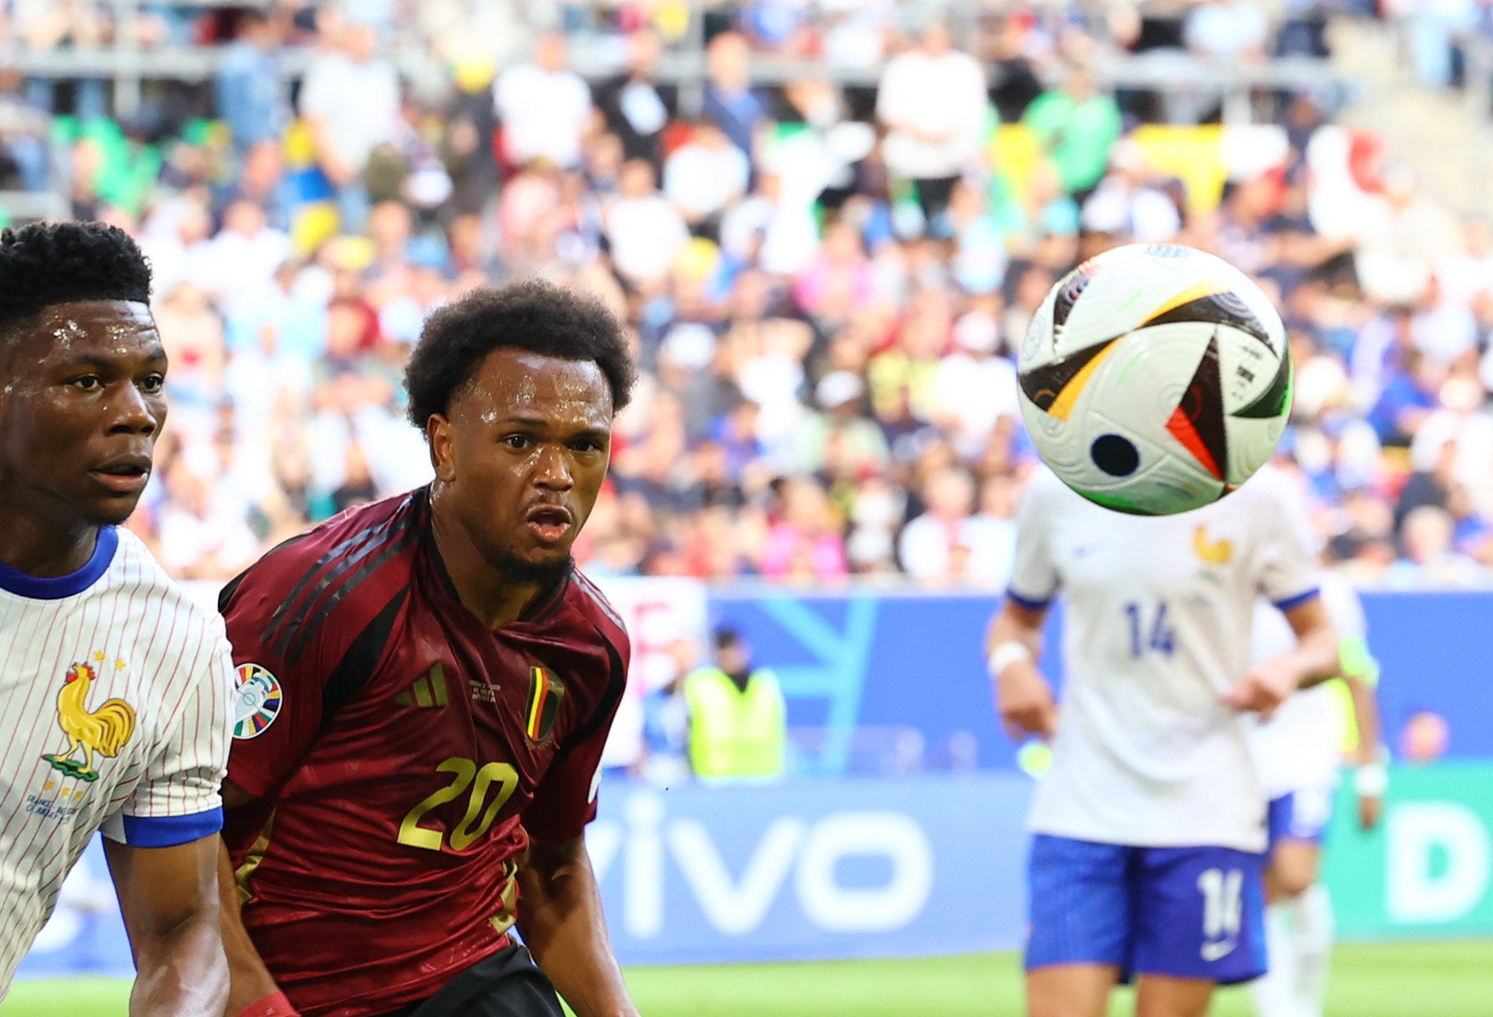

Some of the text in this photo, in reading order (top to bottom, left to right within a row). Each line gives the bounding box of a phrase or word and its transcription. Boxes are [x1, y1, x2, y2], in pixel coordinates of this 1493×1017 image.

[1122, 601, 1177, 659] 14
[397, 757, 519, 851] 20
[1387, 801, 1490, 923] D
